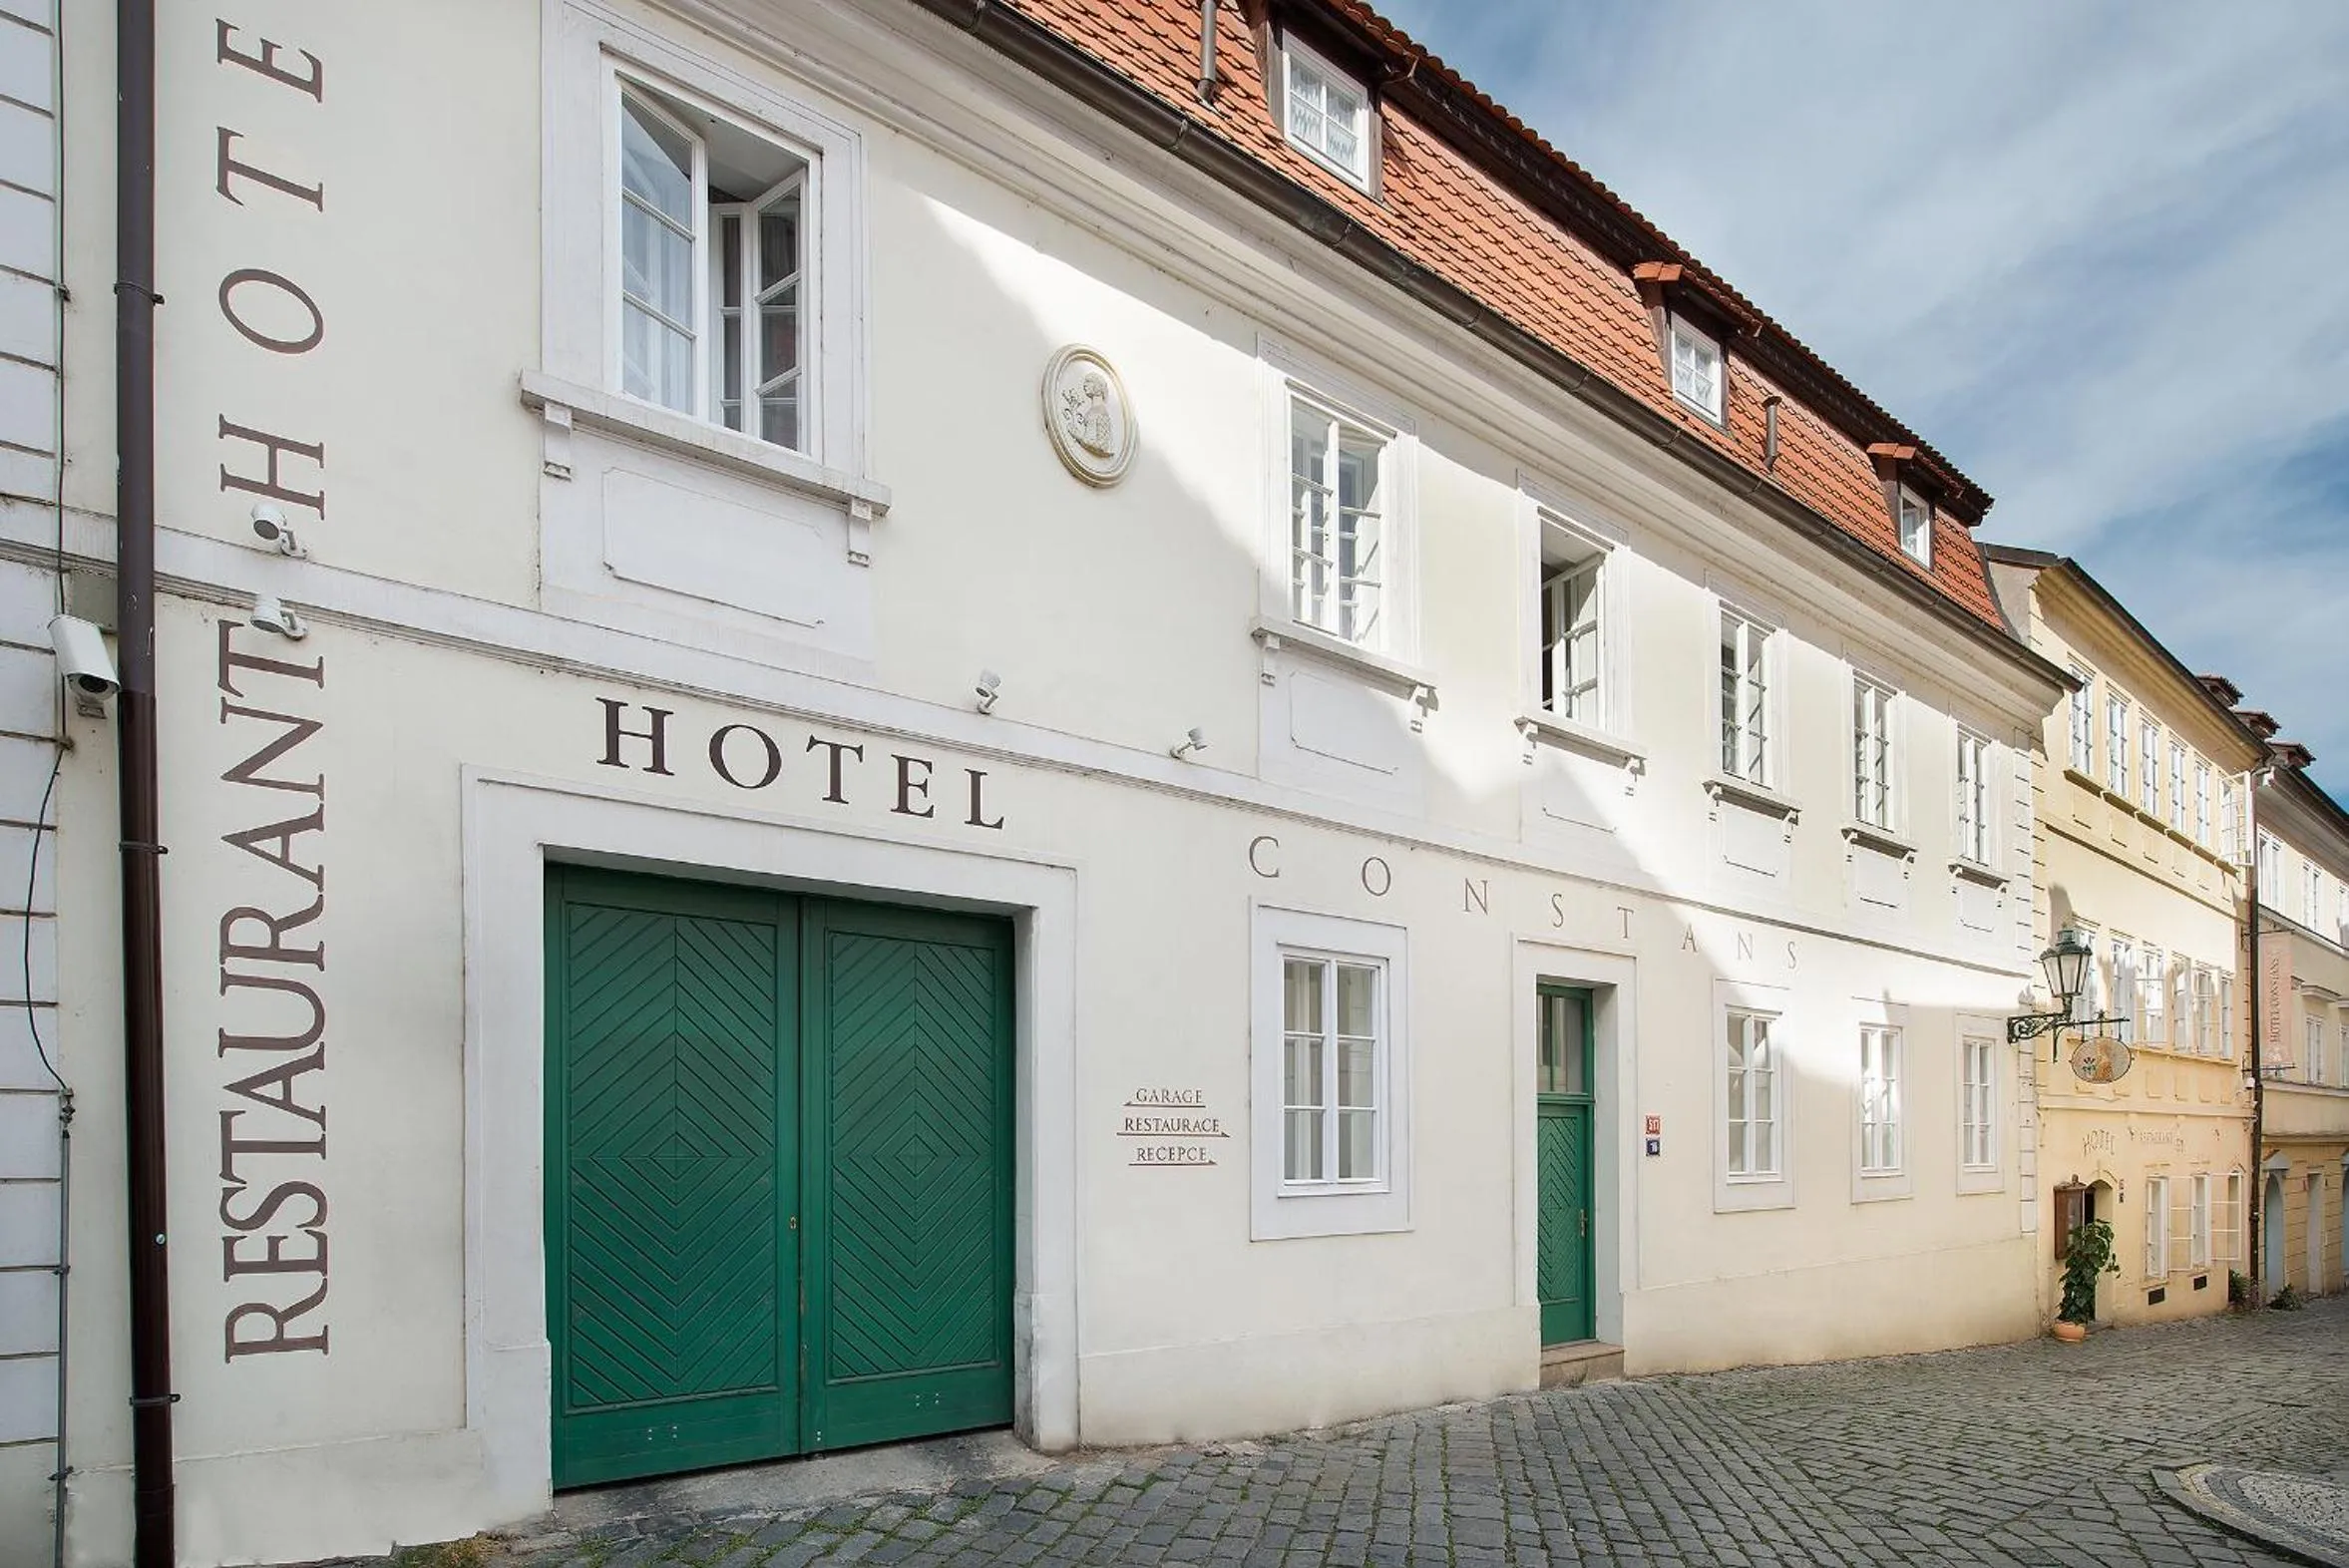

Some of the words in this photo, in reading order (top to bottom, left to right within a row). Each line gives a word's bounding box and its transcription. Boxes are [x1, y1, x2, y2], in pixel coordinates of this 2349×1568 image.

[595, 696, 1004, 830] HOTEL
[1249, 835, 1797, 970] CONSTANS
[217, 619, 330, 1365] RESTAURANT
[1124, 1116, 1220, 1133] RESTAURACE
[1135, 1087, 1203, 1103] GARAGE
[1136, 1146, 1207, 1162] RECEPCE
